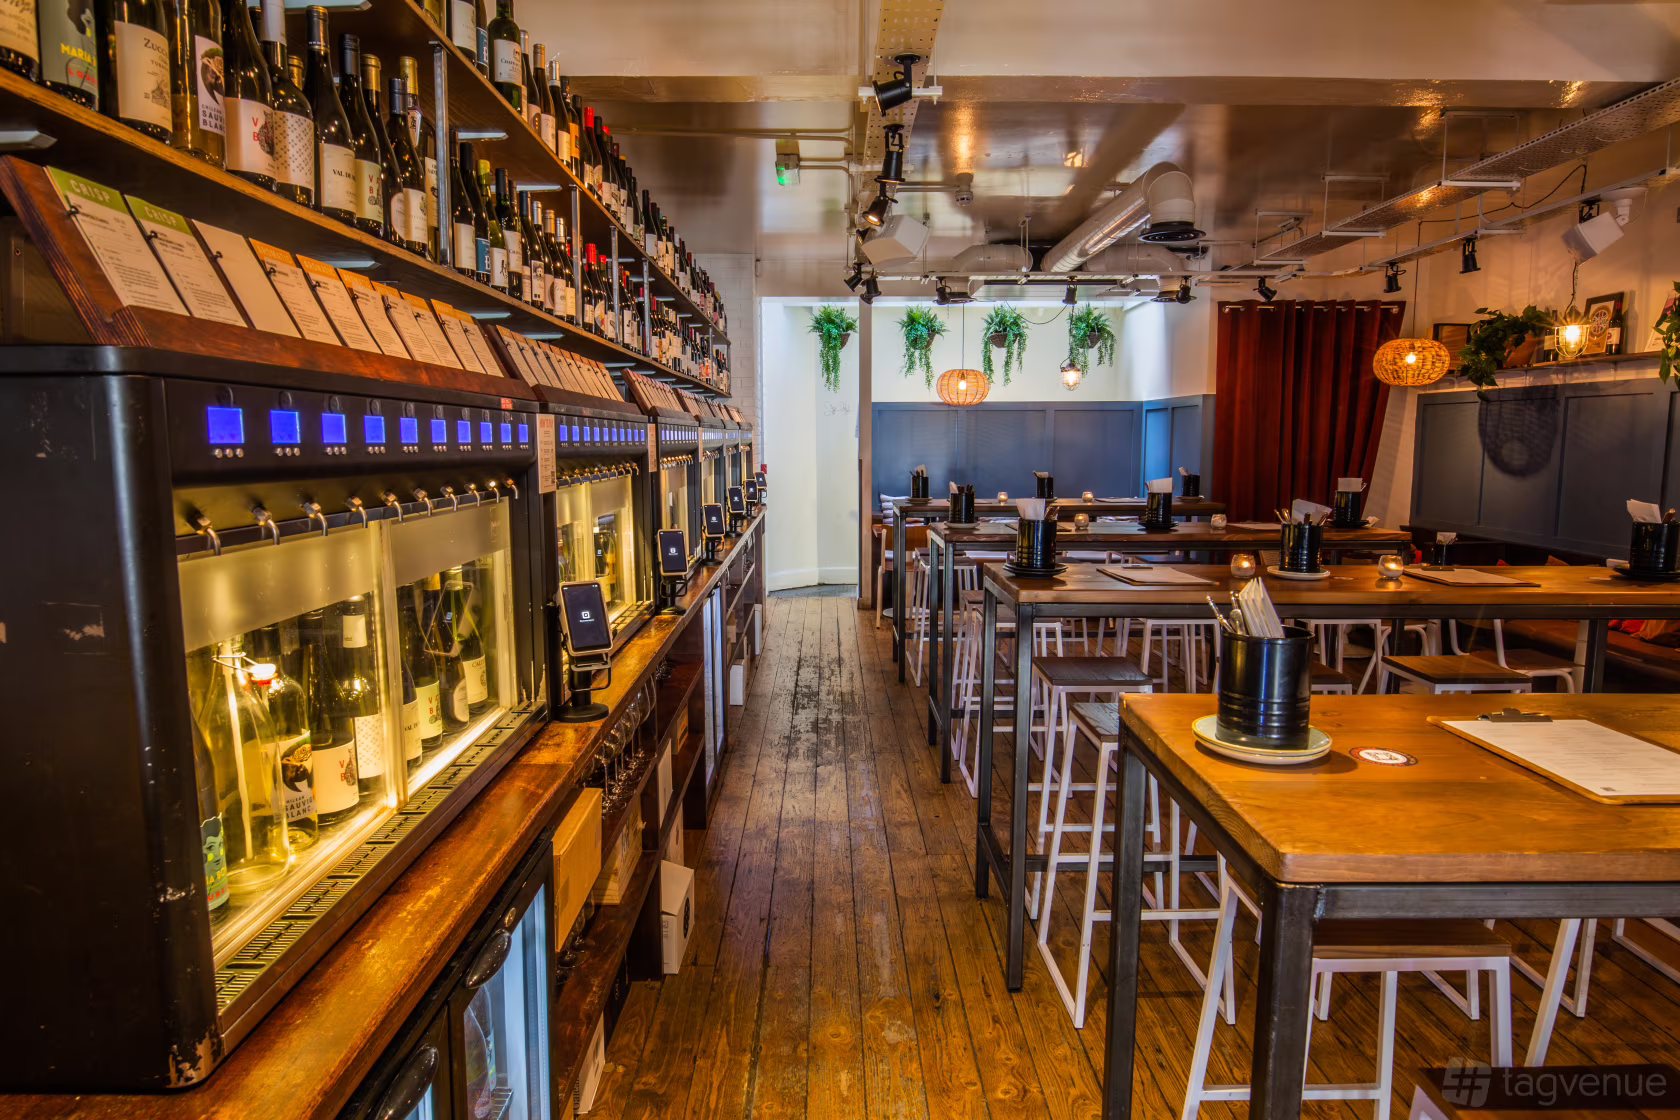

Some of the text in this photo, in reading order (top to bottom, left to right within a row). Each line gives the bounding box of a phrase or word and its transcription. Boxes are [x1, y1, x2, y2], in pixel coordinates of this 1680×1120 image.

[70, 180, 110, 202] CRISP
[144, 206, 176, 227] CRISP
[286, 796, 305, 804] HILEAN
